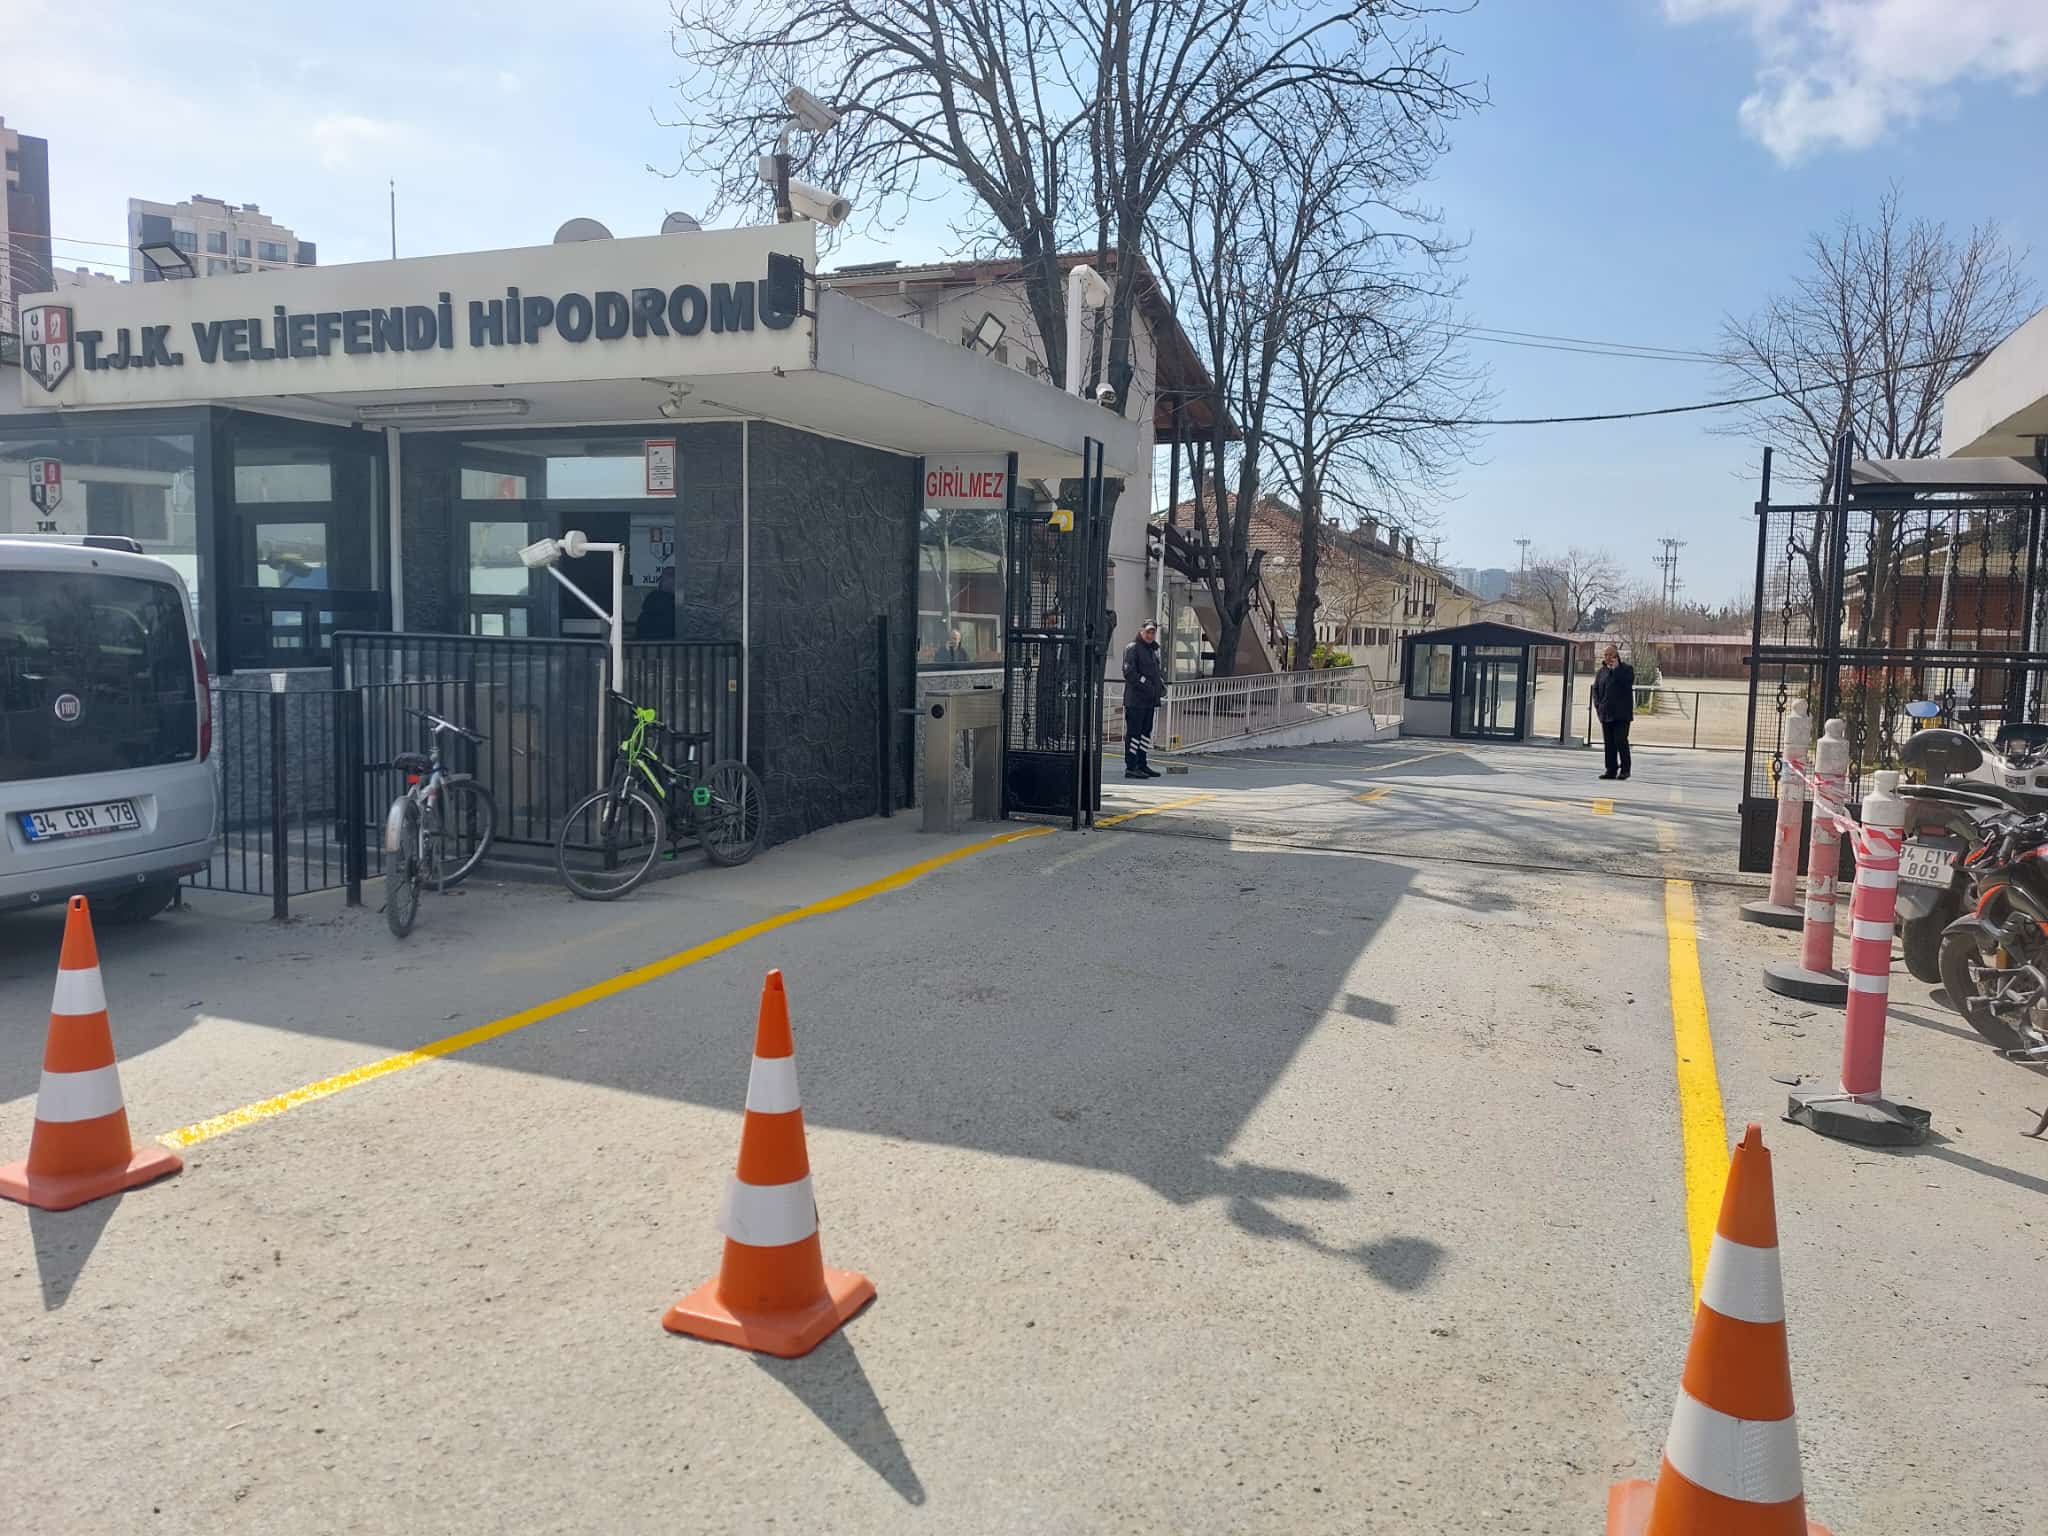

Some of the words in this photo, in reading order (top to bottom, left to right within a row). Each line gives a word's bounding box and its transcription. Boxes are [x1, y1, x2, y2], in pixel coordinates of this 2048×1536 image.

[76, 325, 184, 370] T.J.K.
[191, 292, 454, 364] VELİEFENDİ
[926, 465, 1004, 498] GİRİLMEZ
[36, 521, 58, 532] TJK
[33, 814, 57, 833] 34
[65, 808, 97, 829] CBY
[104, 804, 133, 823] 178
